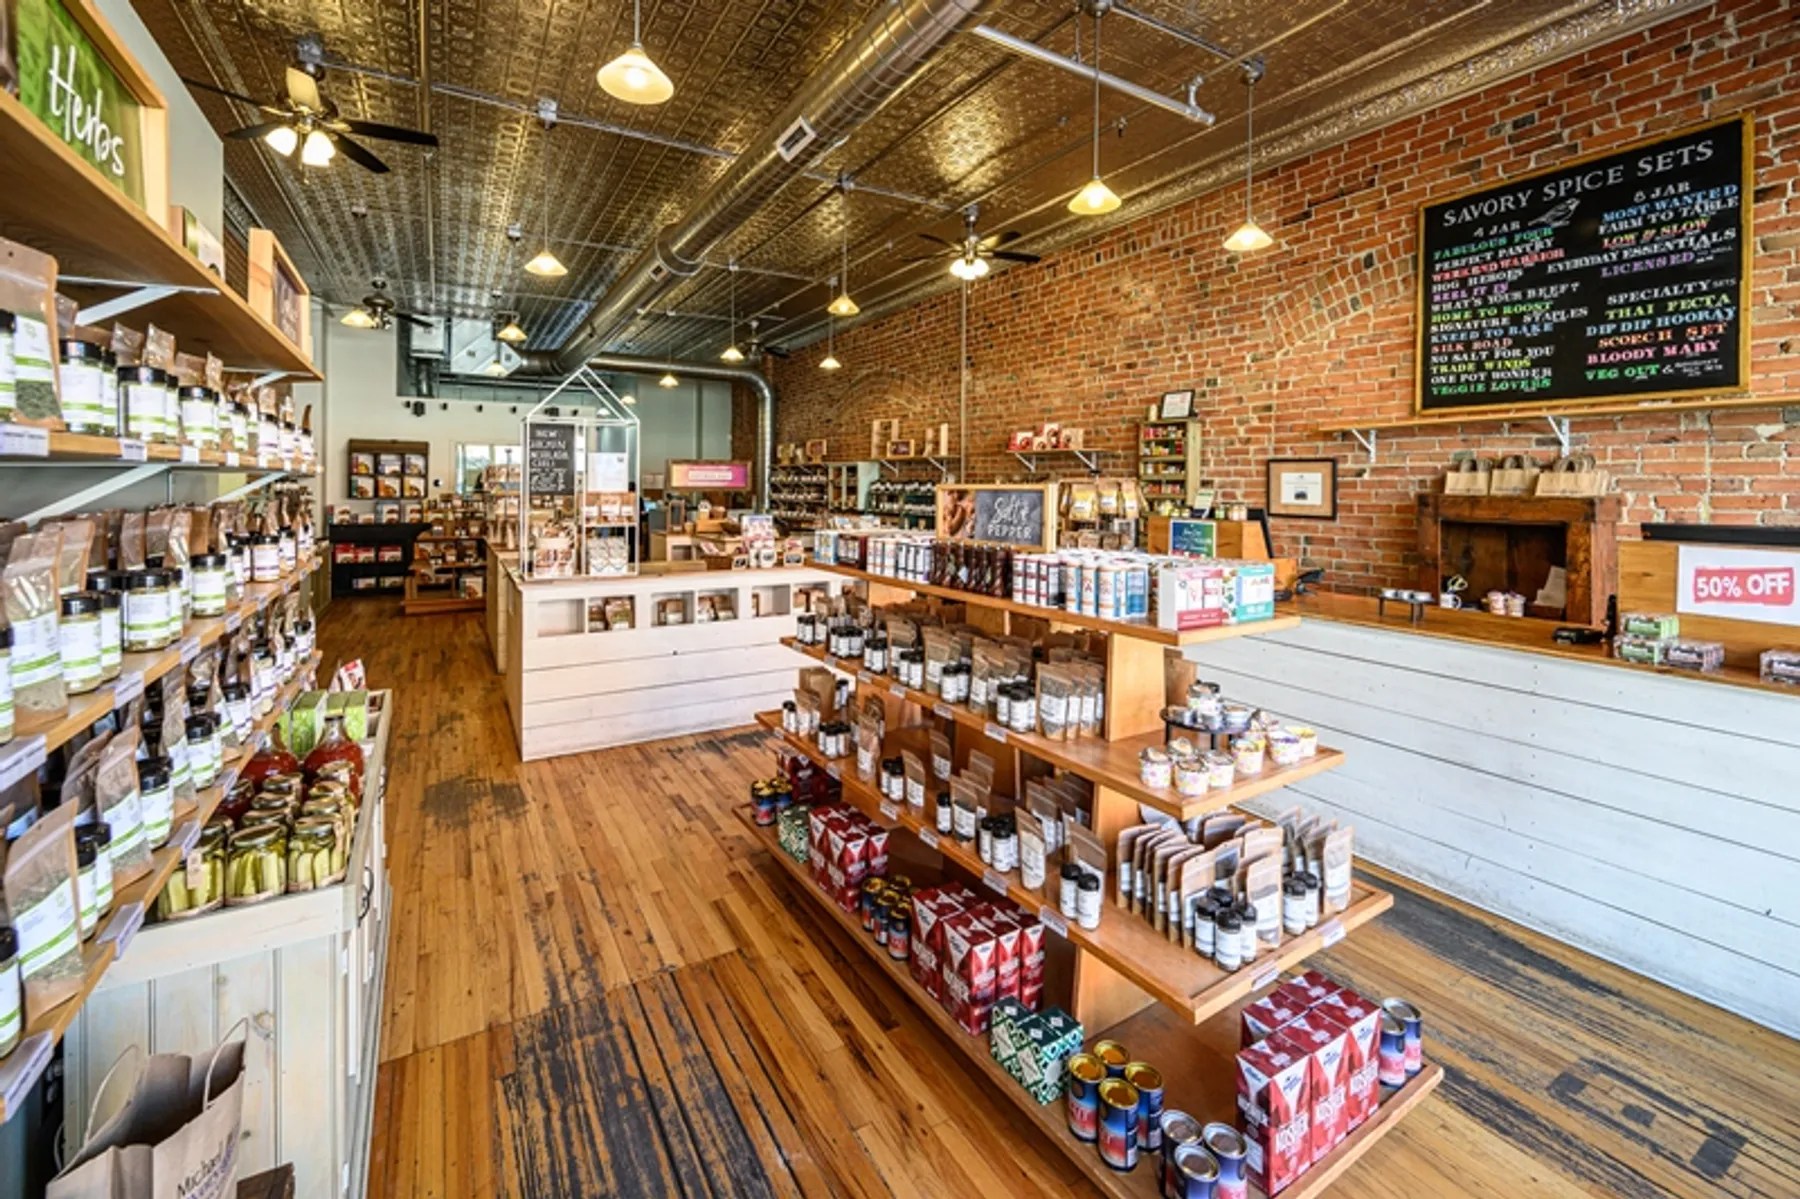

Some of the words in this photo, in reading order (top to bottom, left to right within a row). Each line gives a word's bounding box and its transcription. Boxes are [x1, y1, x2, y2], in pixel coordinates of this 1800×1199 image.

[48, 45, 125, 177] Herbs
[1443, 189, 1533, 227] SAVORY
[1543, 166, 1624, 201] SPICE
[1637, 140, 1714, 177] SETS
[1650, 181, 1691, 199] JAR
[1598, 217, 1643, 236] FARM
[1647, 210, 1674, 225] TO
[1679, 196, 1739, 216] TABLE
[1602, 202, 1650, 223] MOST
[1654, 184, 1739, 212] WANTED
[1489, 221, 1521, 235] JAR
[1602, 232, 1639, 249] LOW
[1660, 216, 1711, 236] SLOW
[1433, 235, 1508, 260] FABULOUS
[1514, 227, 1553, 243] FOUR
[1435, 252, 1495, 272] PERFECT
[1498, 237, 1555, 258] PANTRY
[1547, 250, 1620, 275] EVERYDAY
[1622, 228, 1737, 260] ESSENTIALS
[1432, 262, 1499, 283] WEEKEND
[1600, 251, 1695, 278] LICENSED
[1432, 281, 1460, 293] HOG
[1467, 268, 1524, 287] HEROES
[1433, 290, 1468, 302] REEL
[1473, 286, 1488, 296] IT
[1493, 282, 1509, 294] IN
[1607, 279, 1712, 306] SPECIALTY
[1431, 297, 1482, 312] WHAT'S
[1487, 290, 1523, 305] YOUR
[1431, 310, 1473, 323] HOME
[1477, 307, 1498, 318] TO
[1502, 301, 1554, 315] ROOST
[1605, 303, 1655, 321] THAI
[1430, 317, 1511, 334] SIGNATURE
[1523, 306, 1588, 323] STAPLES
[1586, 323, 1617, 337] DIP
[1620, 319, 1653, 333] DIP
[1656, 306, 1737, 327] HOORAY
[1430, 332, 1480, 344] KNEED
[1484, 328, 1505, 339] TO
[1508, 322, 1554, 336] BAKE
[1431, 342, 1465, 354] SILK
[1471, 337, 1513, 350] ROAD
[1598, 328, 1673, 348] SCORCH
[1686, 322, 1728, 337] SET
[1430, 354, 1448, 363] NO
[1451, 350, 1489, 362] SALT
[1494, 348, 1522, 359] FOR
[1527, 345, 1555, 359] YOU
[1586, 346, 1657, 365] BLOODY
[1663, 340, 1721, 357] MARY
[1430, 374, 1457, 385] ONE
[1460, 371, 1489, 383] POT
[1491, 367, 1553, 380] WONDER
[1431, 362, 1477, 374] TRADE
[1484, 358, 1531, 370] WINDS
[1584, 368, 1620, 382] VEG
[1624, 363, 1660, 378] OUT
[1431, 383, 1486, 396] VEGGIE
[1490, 378, 1551, 391] LOVERS
[1696, 576, 1743, 598] 50%
[1747, 572, 1791, 595] OFF
